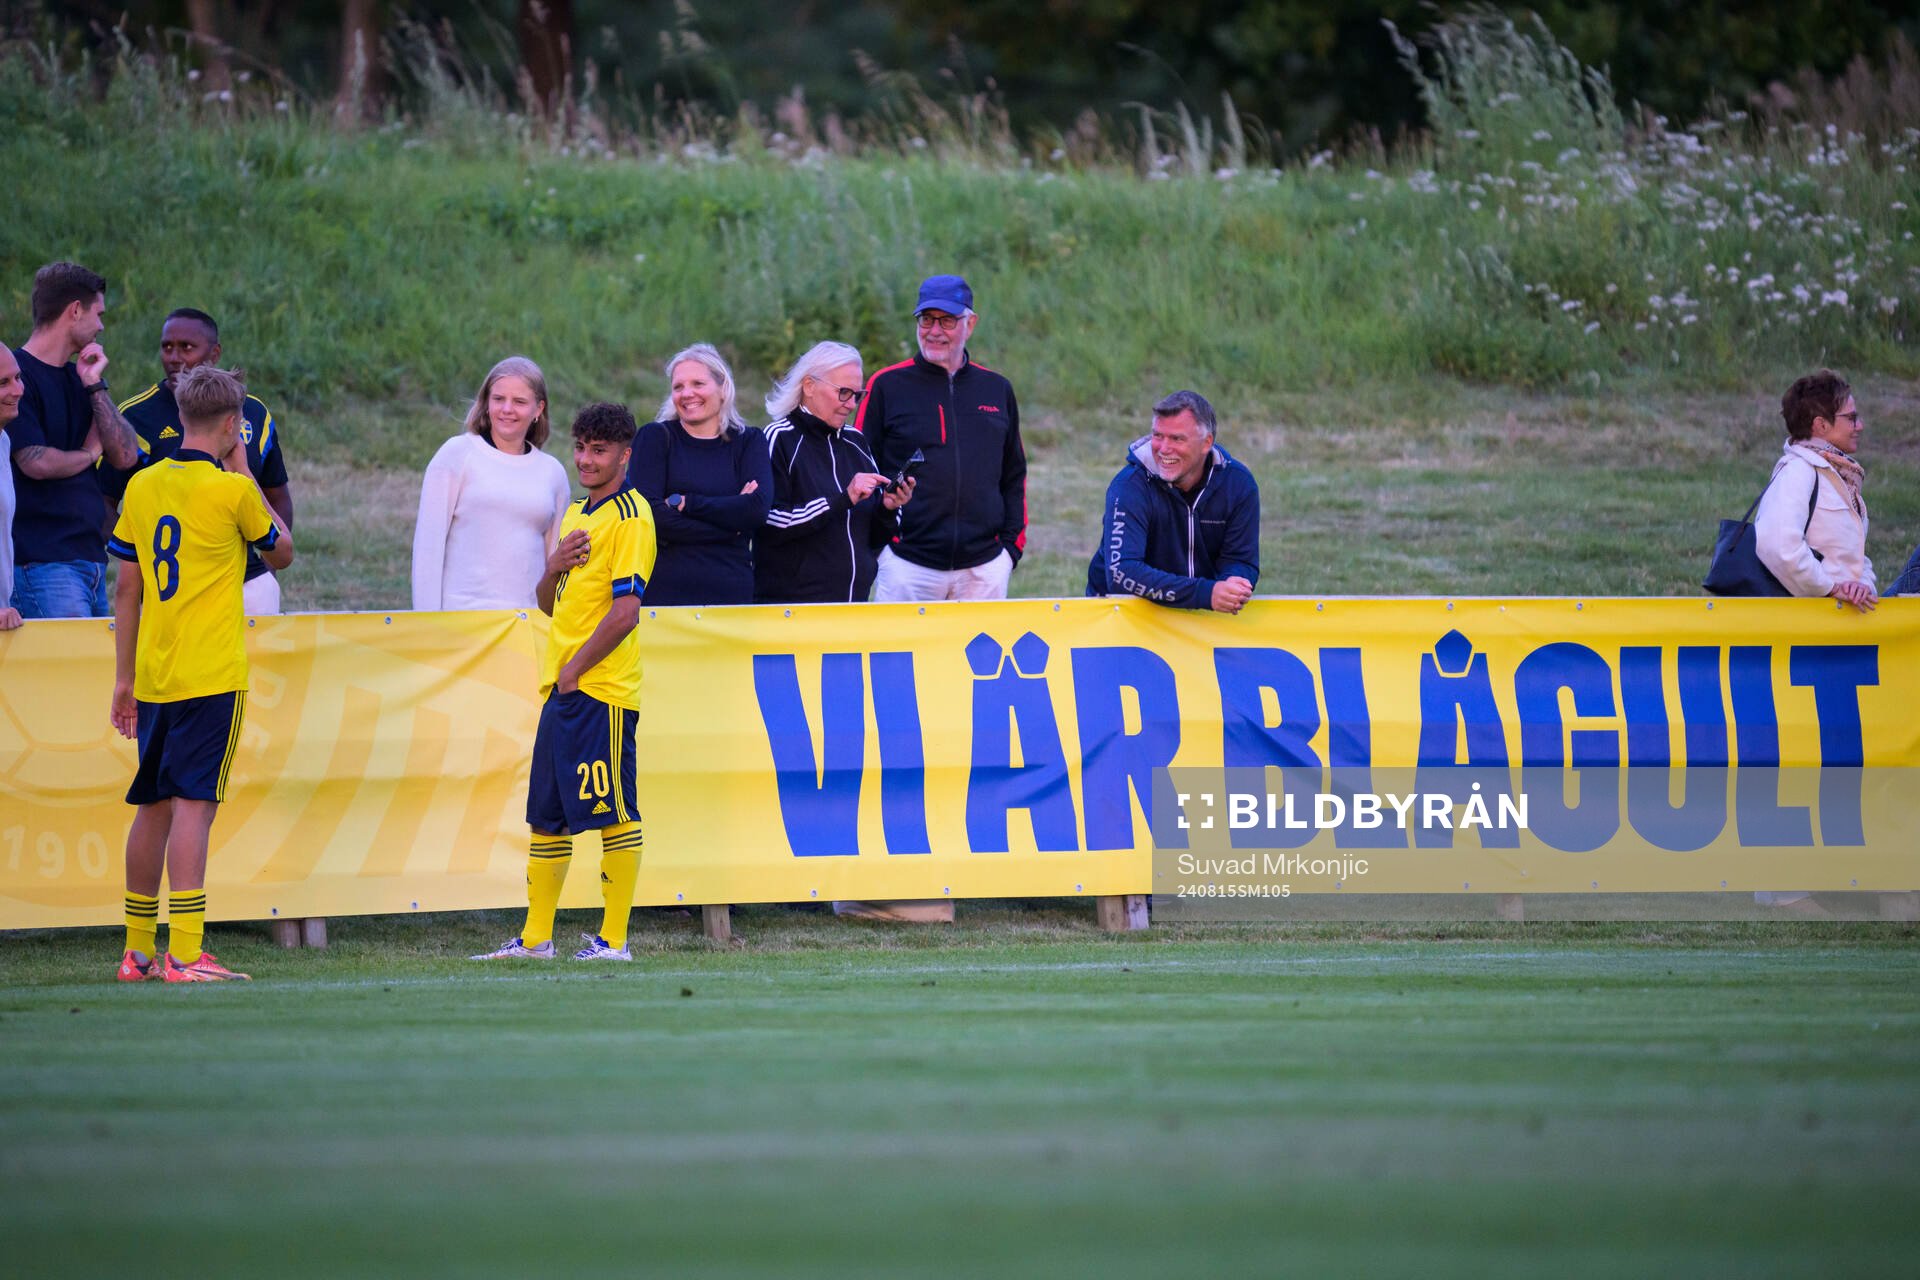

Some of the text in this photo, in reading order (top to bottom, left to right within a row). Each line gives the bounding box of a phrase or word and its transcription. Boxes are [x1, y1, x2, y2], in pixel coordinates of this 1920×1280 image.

[153, 515, 181, 602] 8
[753, 629, 1879, 857] VI ÄR BLÅGULT
[577, 760, 609, 800] 20
[3, 824, 131, 879] 190
